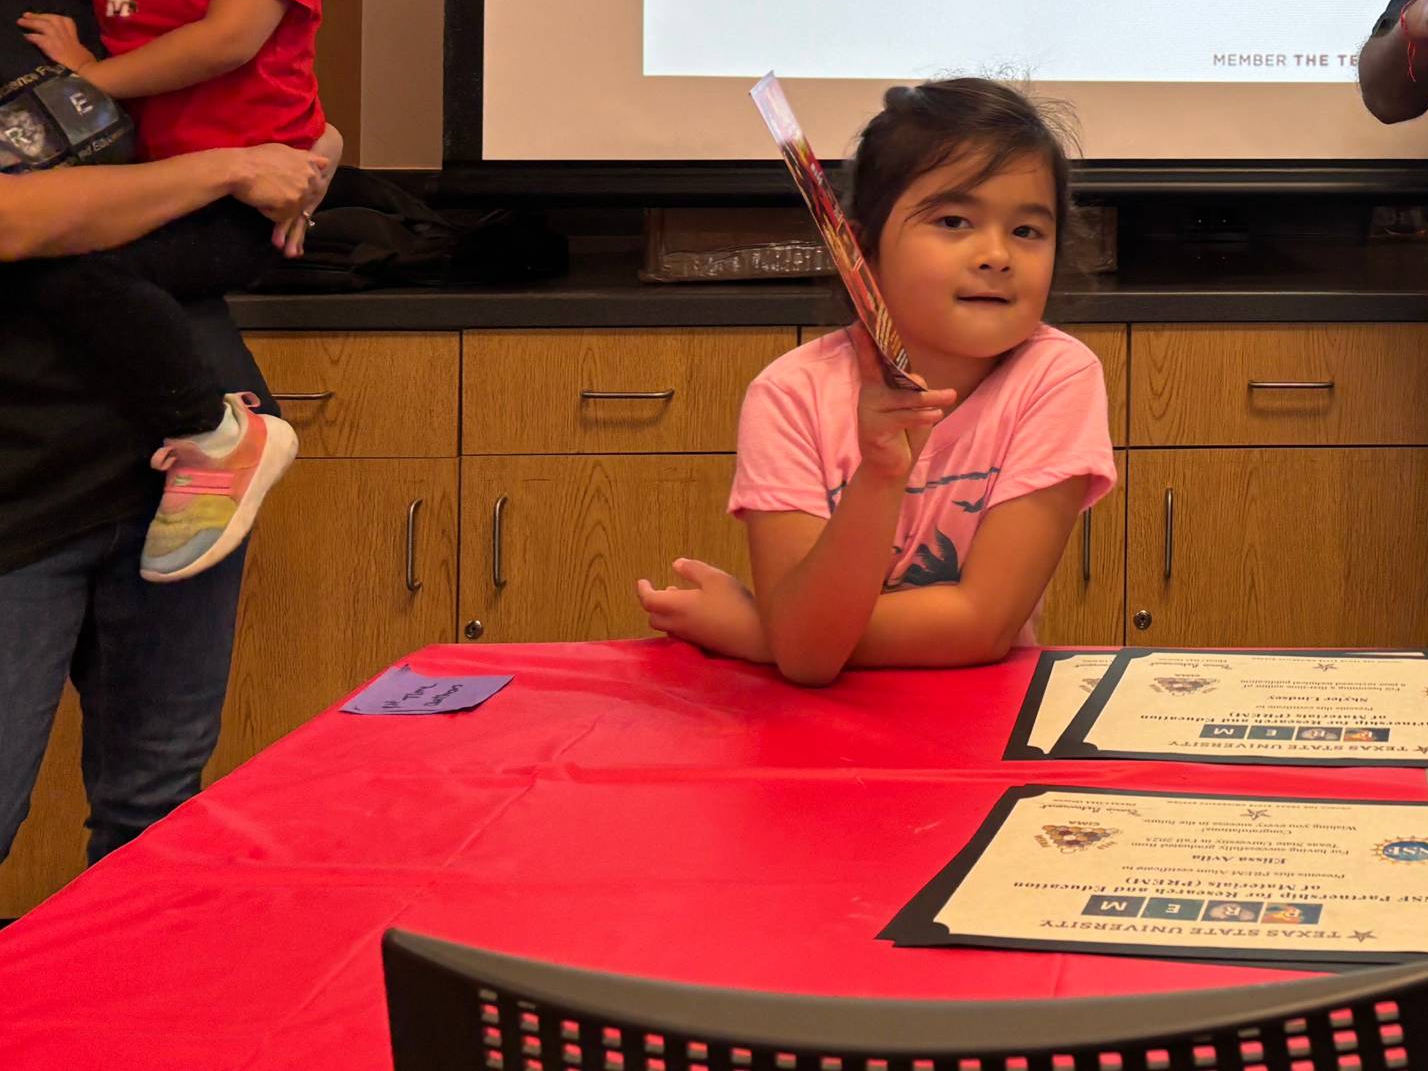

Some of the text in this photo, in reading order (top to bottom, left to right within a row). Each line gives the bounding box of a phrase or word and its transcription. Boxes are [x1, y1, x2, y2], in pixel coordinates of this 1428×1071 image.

[1212, 54, 1287, 67] MEMBER
[1294, 54, 1329, 67] THE
[1167, 741, 1282, 750] UNIVERSITY
[1012, 881, 1108, 892] Education
[1124, 876, 1202, 887] (PREM)
[1206, 880, 1296, 891] Materials
[1113, 886, 1148, 894] and
[1154, 888, 1239, 898] Research
[1244, 891, 1273, 900] for
[1279, 891, 1390, 903] Partnership
[1039, 919, 1341, 938] TEXAS STATE UNIVERSITY
